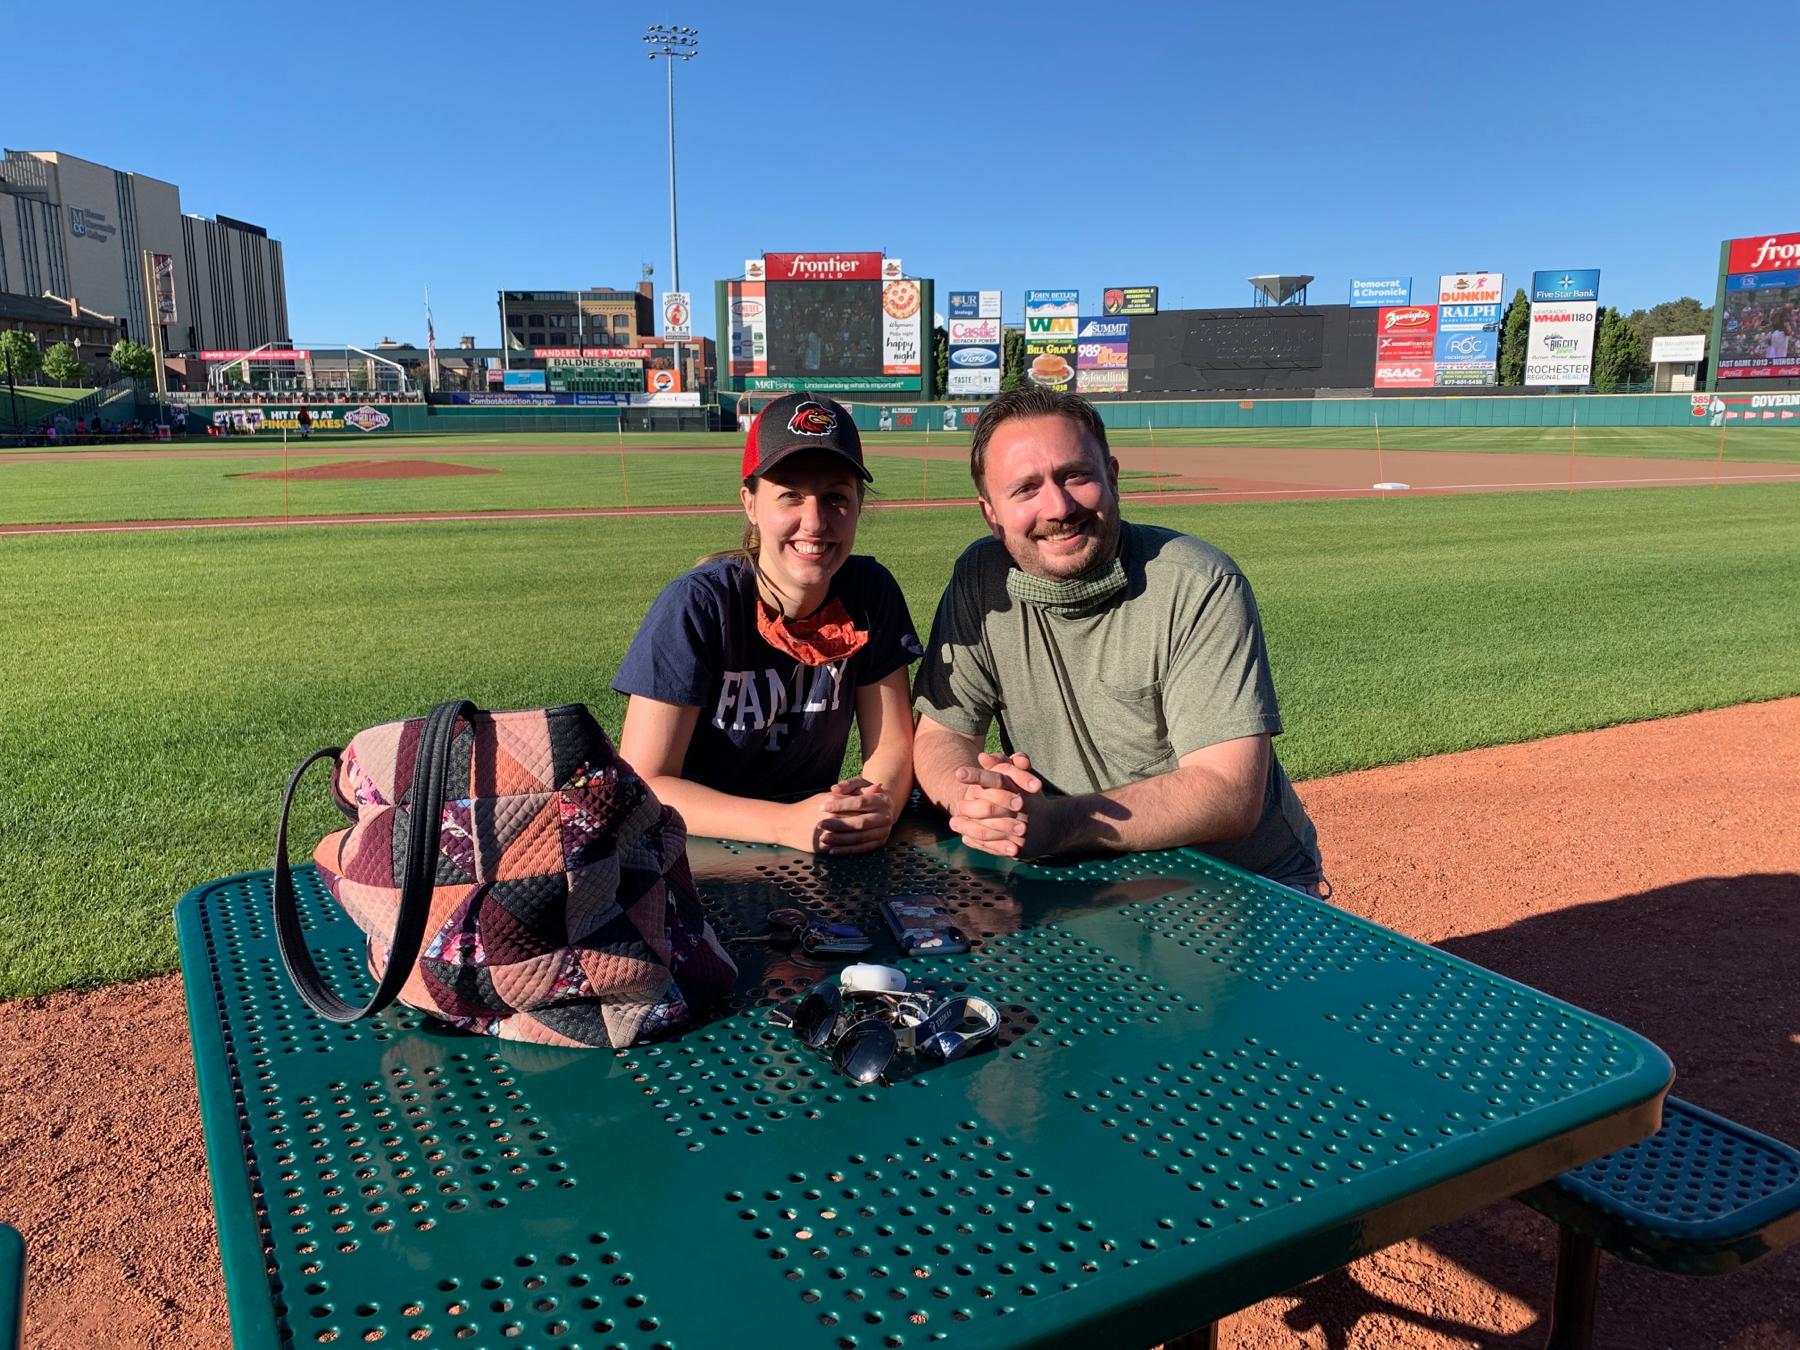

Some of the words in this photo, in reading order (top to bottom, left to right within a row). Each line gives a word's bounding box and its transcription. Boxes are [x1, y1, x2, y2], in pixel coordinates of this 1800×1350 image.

[788, 255, 859, 277] frontier
[1354, 280, 1400, 288] Democrat
[1028, 291, 1050, 302] JOHN
[1361, 288, 1407, 297] Chronicle
[1441, 291, 1500, 302] DUNKIN'
[1573, 289, 1594, 297] Bank
[962, 296, 977, 305] UR
[1443, 305, 1497, 317] RALPH
[952, 319, 997, 338] Castle
[1028, 319, 1074, 332] WM
[1092, 324, 1128, 332] SUMMIT
[887, 337, 913, 351] happy
[1451, 337, 1482, 354] ROC
[1550, 340, 1562, 351] BIG
[1563, 340, 1579, 350] CITY
[612, 349, 648, 357] TOYOTA
[894, 350, 916, 363] night
[960, 351, 987, 363] Ford
[553, 359, 636, 367] BALDNESS.com
[1734, 359, 1751, 367] GAME
[1377, 368, 1422, 378] ISAAC
[1527, 365, 1589, 374] ROCHESTER
[1090, 371, 1128, 382] foodlink
[469, 398, 556, 406] CombatAddiction.ny.gov
[270, 411, 288, 419] HIT
[321, 411, 334, 419] AT
[311, 419, 345, 429] AKES!
